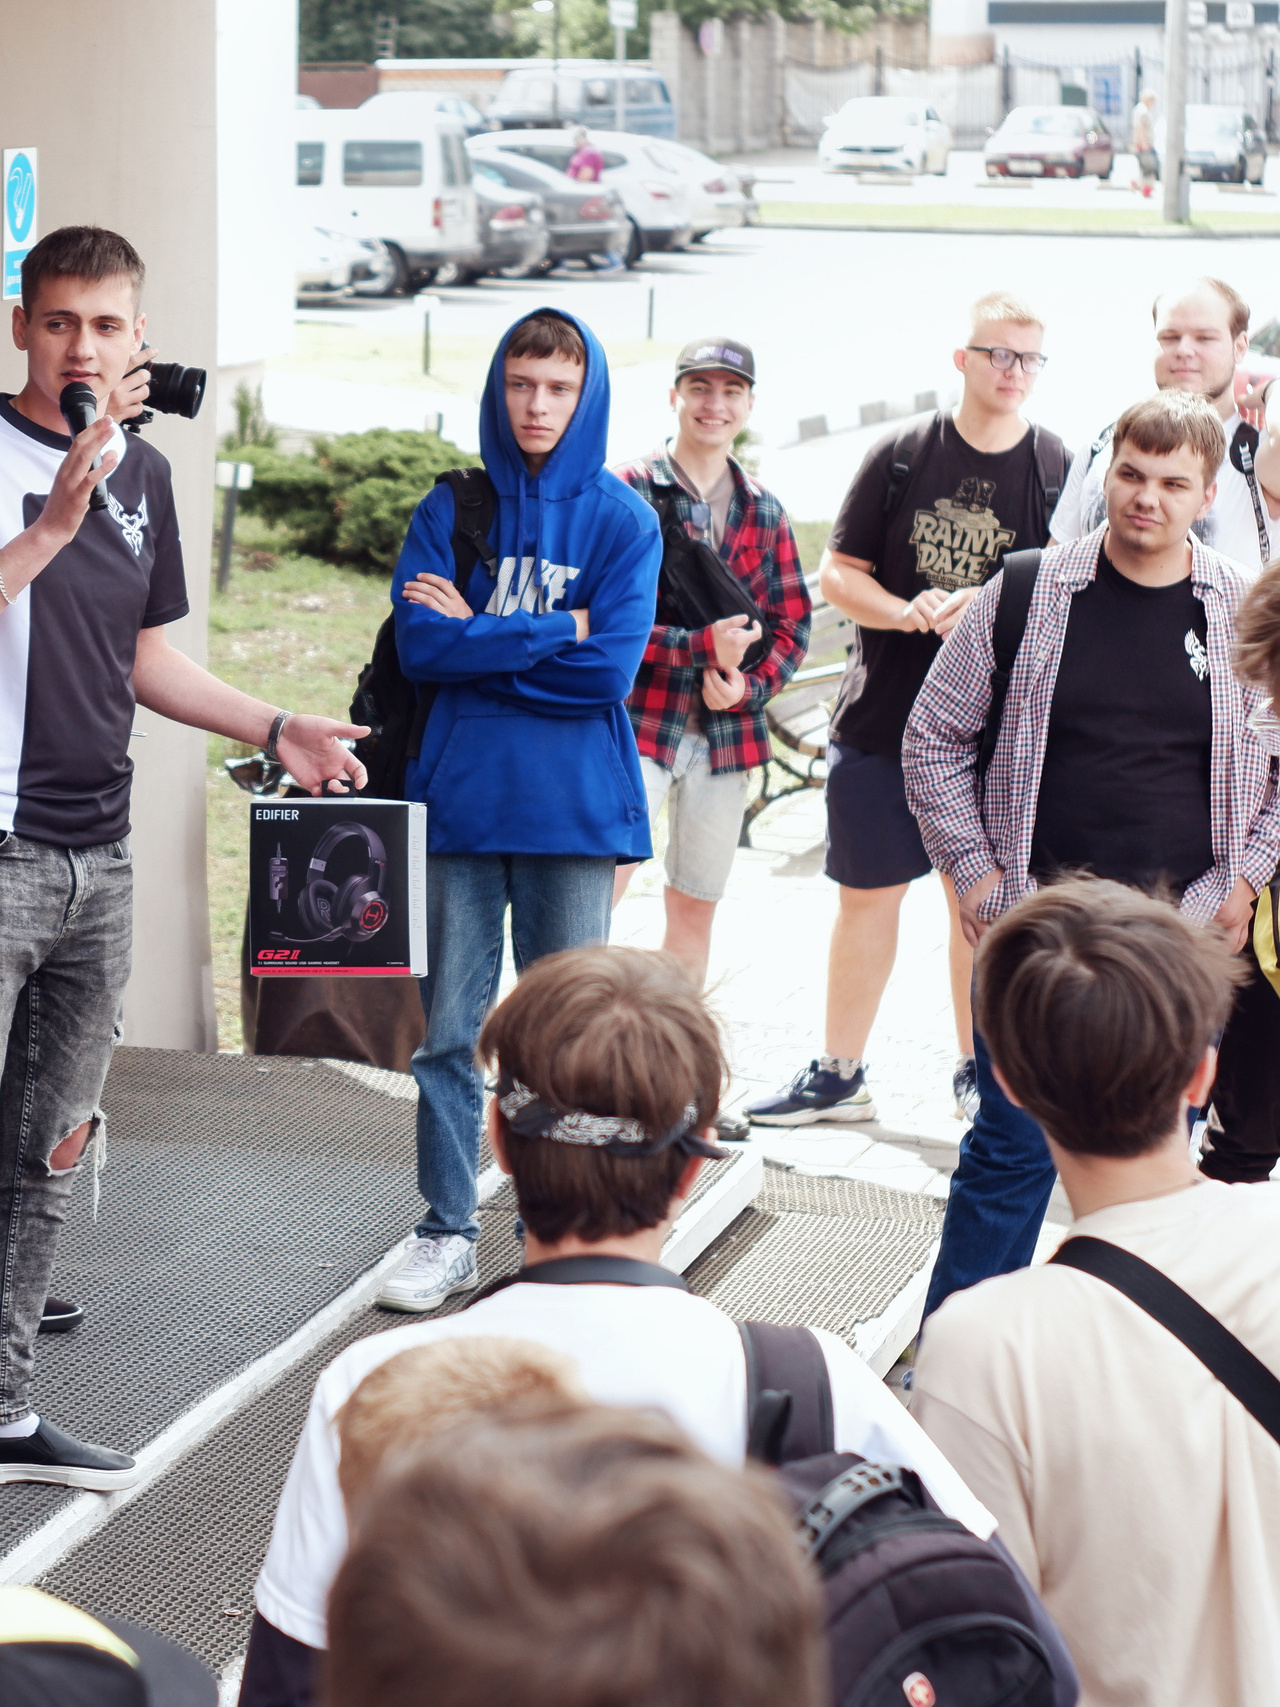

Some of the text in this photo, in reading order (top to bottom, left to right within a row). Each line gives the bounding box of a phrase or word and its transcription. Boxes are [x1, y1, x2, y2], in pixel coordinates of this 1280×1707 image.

[913, 512, 1012, 558] RAINY
[919, 542, 988, 580] DAZE
[255, 809, 300, 821] EDIFIER
